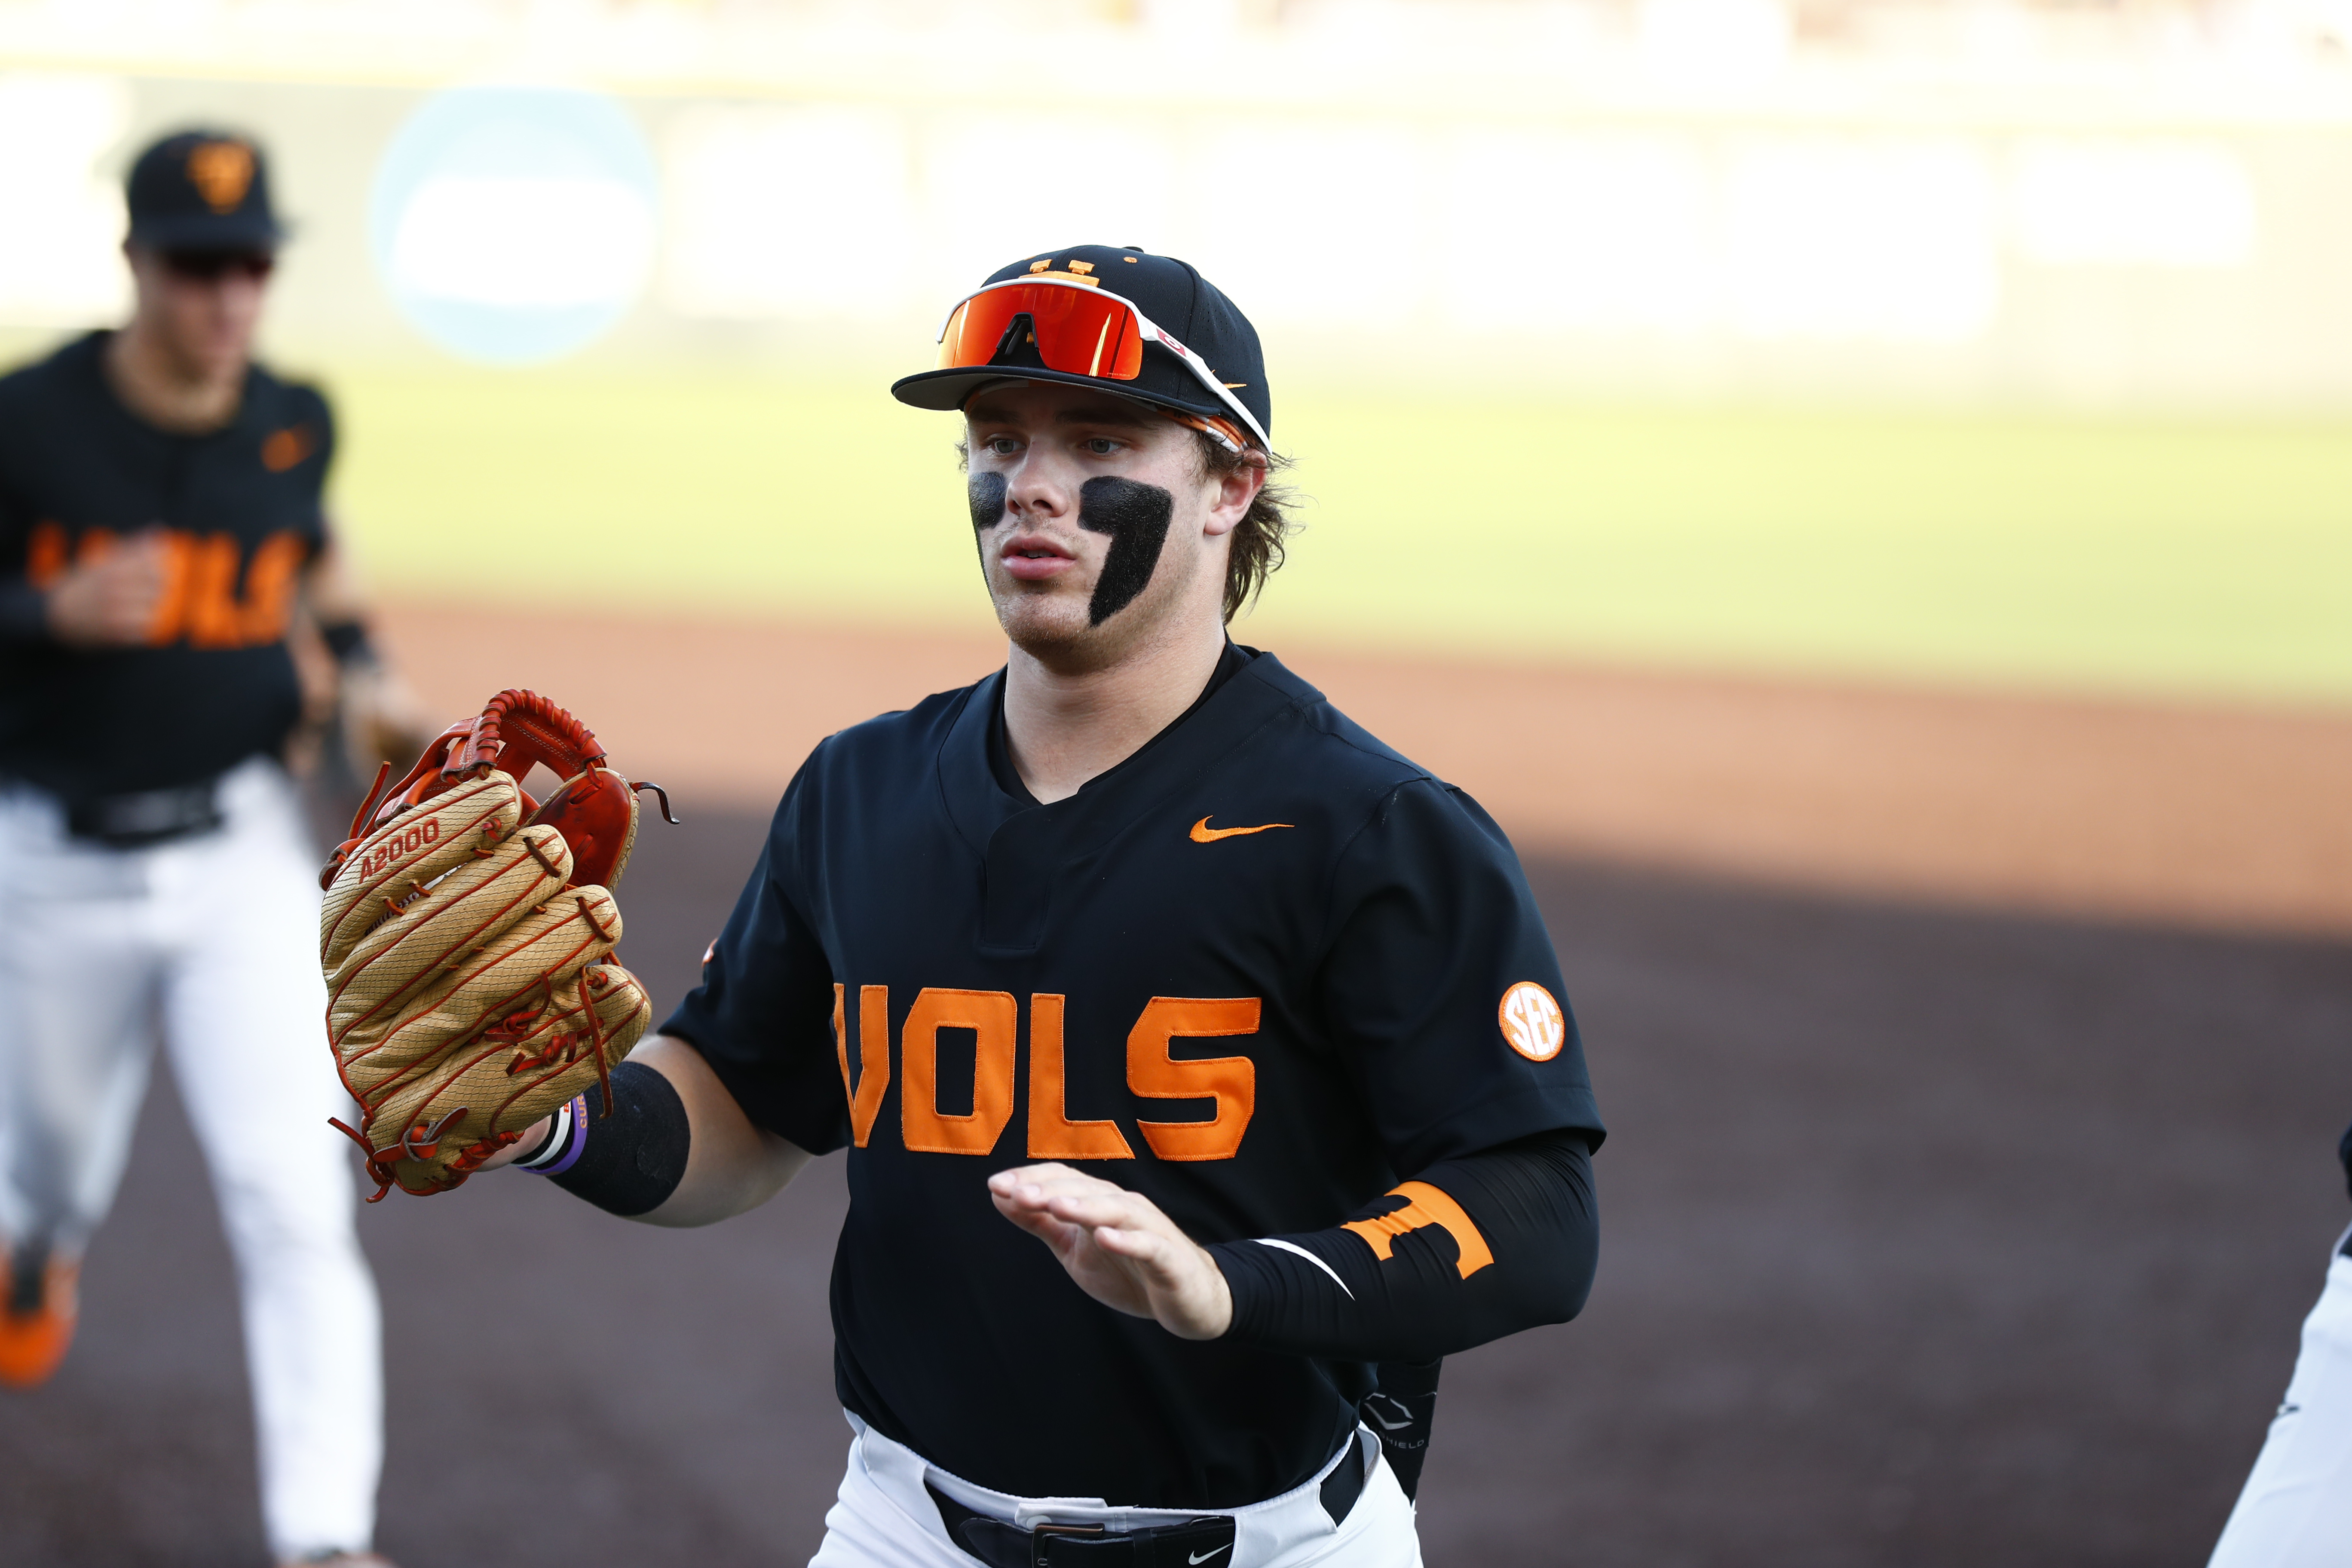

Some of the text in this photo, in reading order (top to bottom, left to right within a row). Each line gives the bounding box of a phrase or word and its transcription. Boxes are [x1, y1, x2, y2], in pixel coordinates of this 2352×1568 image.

[359, 818, 439, 884] A2000
[1505, 986, 1559, 1055] SEC
[833, 983, 1262, 1161] VOLS
